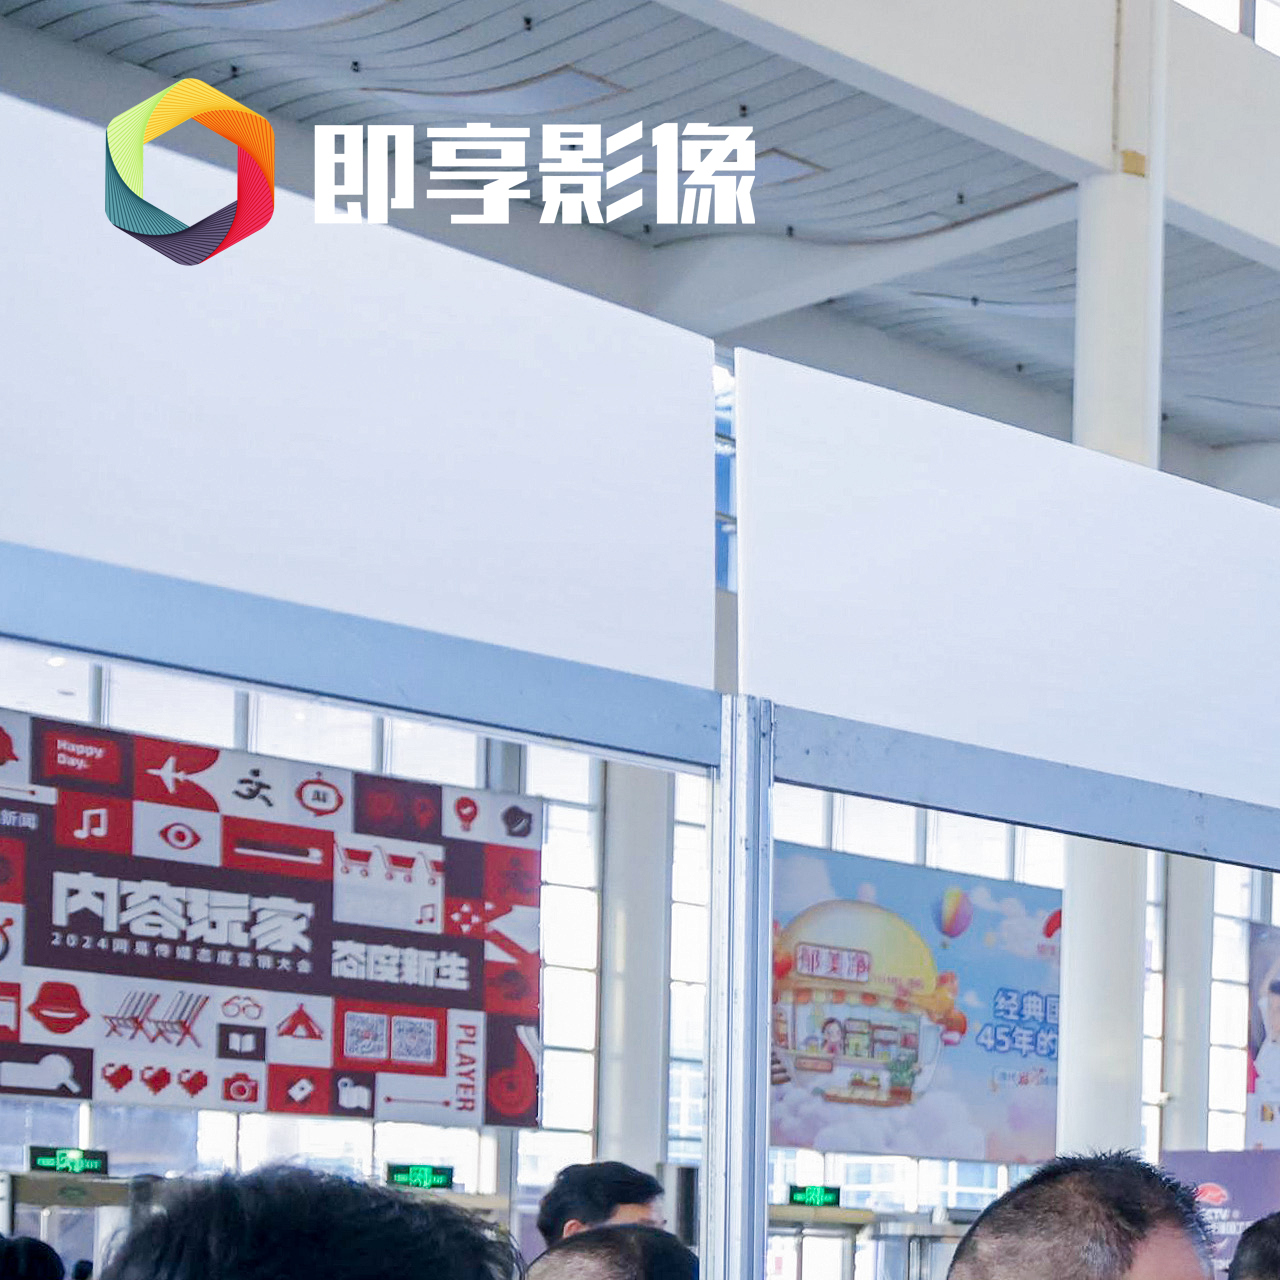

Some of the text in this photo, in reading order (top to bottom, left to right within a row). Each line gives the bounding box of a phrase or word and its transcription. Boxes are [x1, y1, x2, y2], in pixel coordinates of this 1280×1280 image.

[57, 739, 105, 759] Happy
[52, 871, 315, 953] 内容玩家
[456, 1023, 476, 1112] PLAYER
